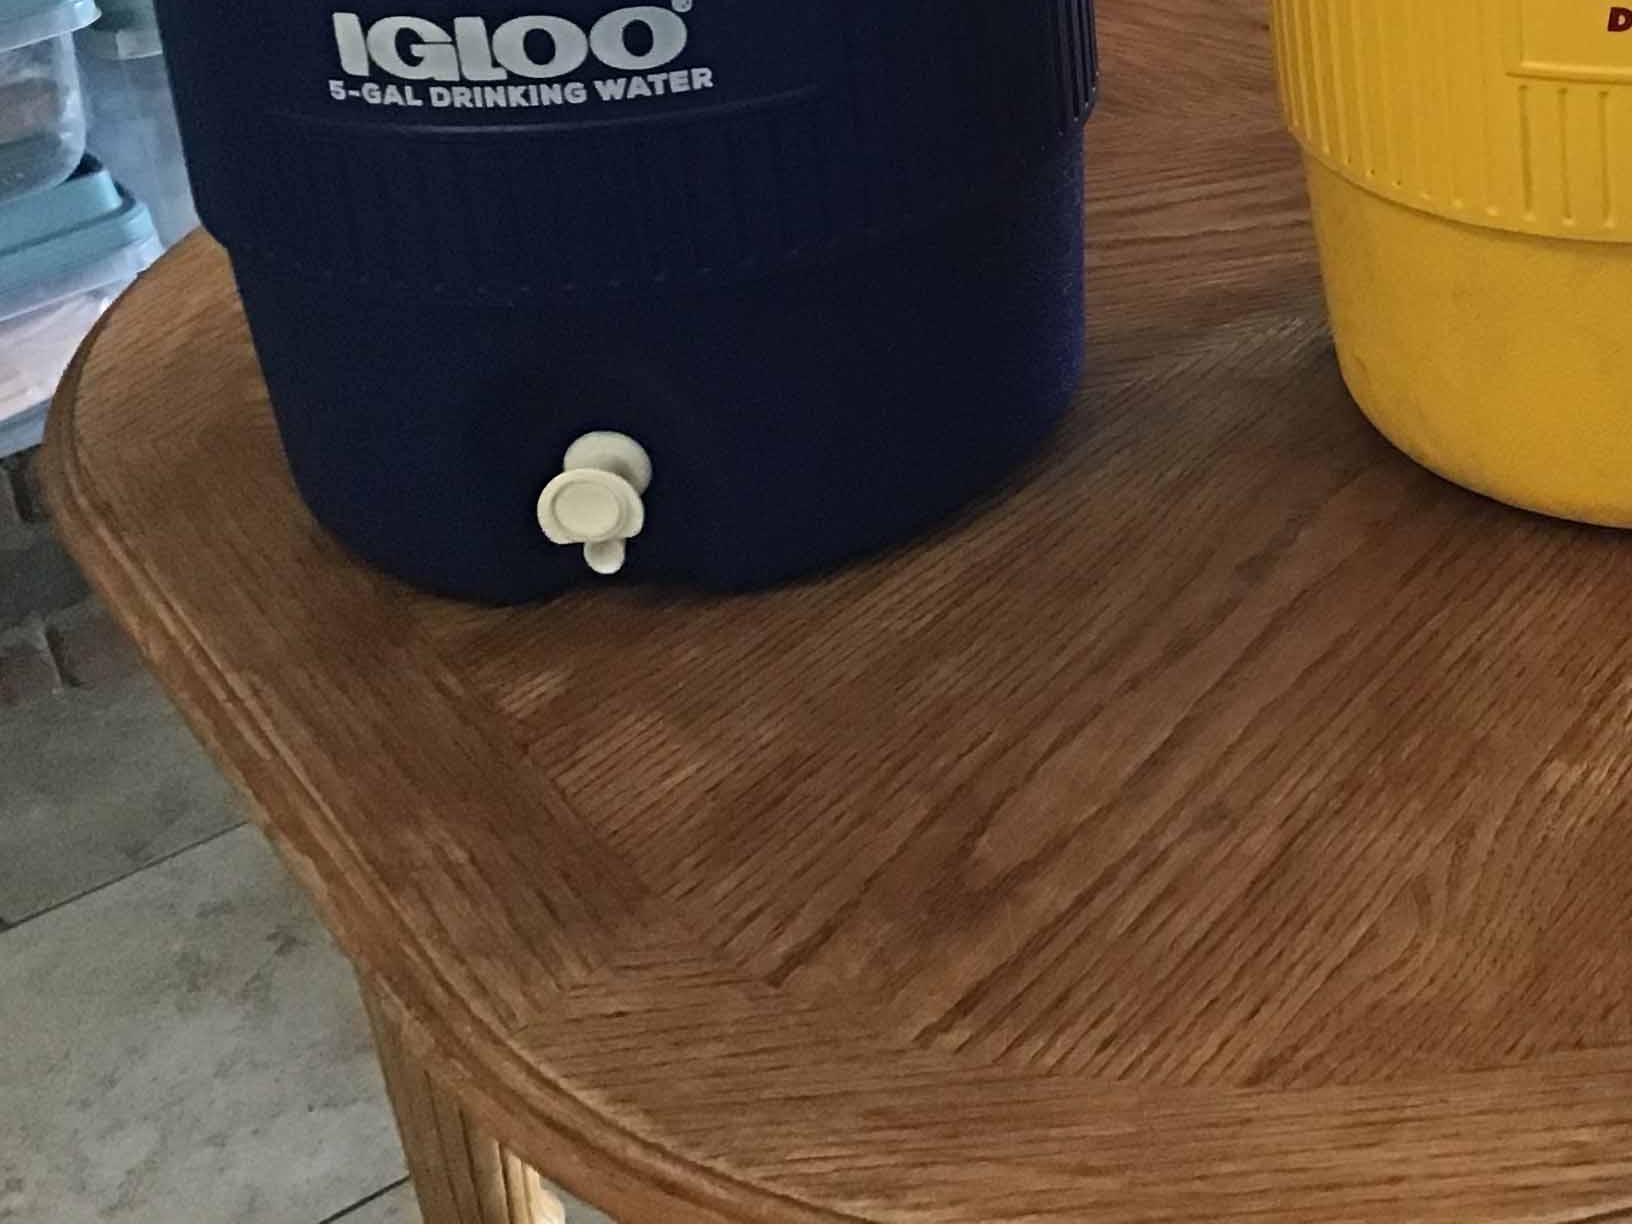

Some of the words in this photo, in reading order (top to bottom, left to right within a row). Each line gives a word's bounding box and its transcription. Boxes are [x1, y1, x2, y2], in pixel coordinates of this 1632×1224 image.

[332, 5, 688, 81] IGLOO
[328, 79, 423, 107] 5-GAL
[430, 80, 588, 108] DRINKING
[594, 67, 714, 101] WATER
